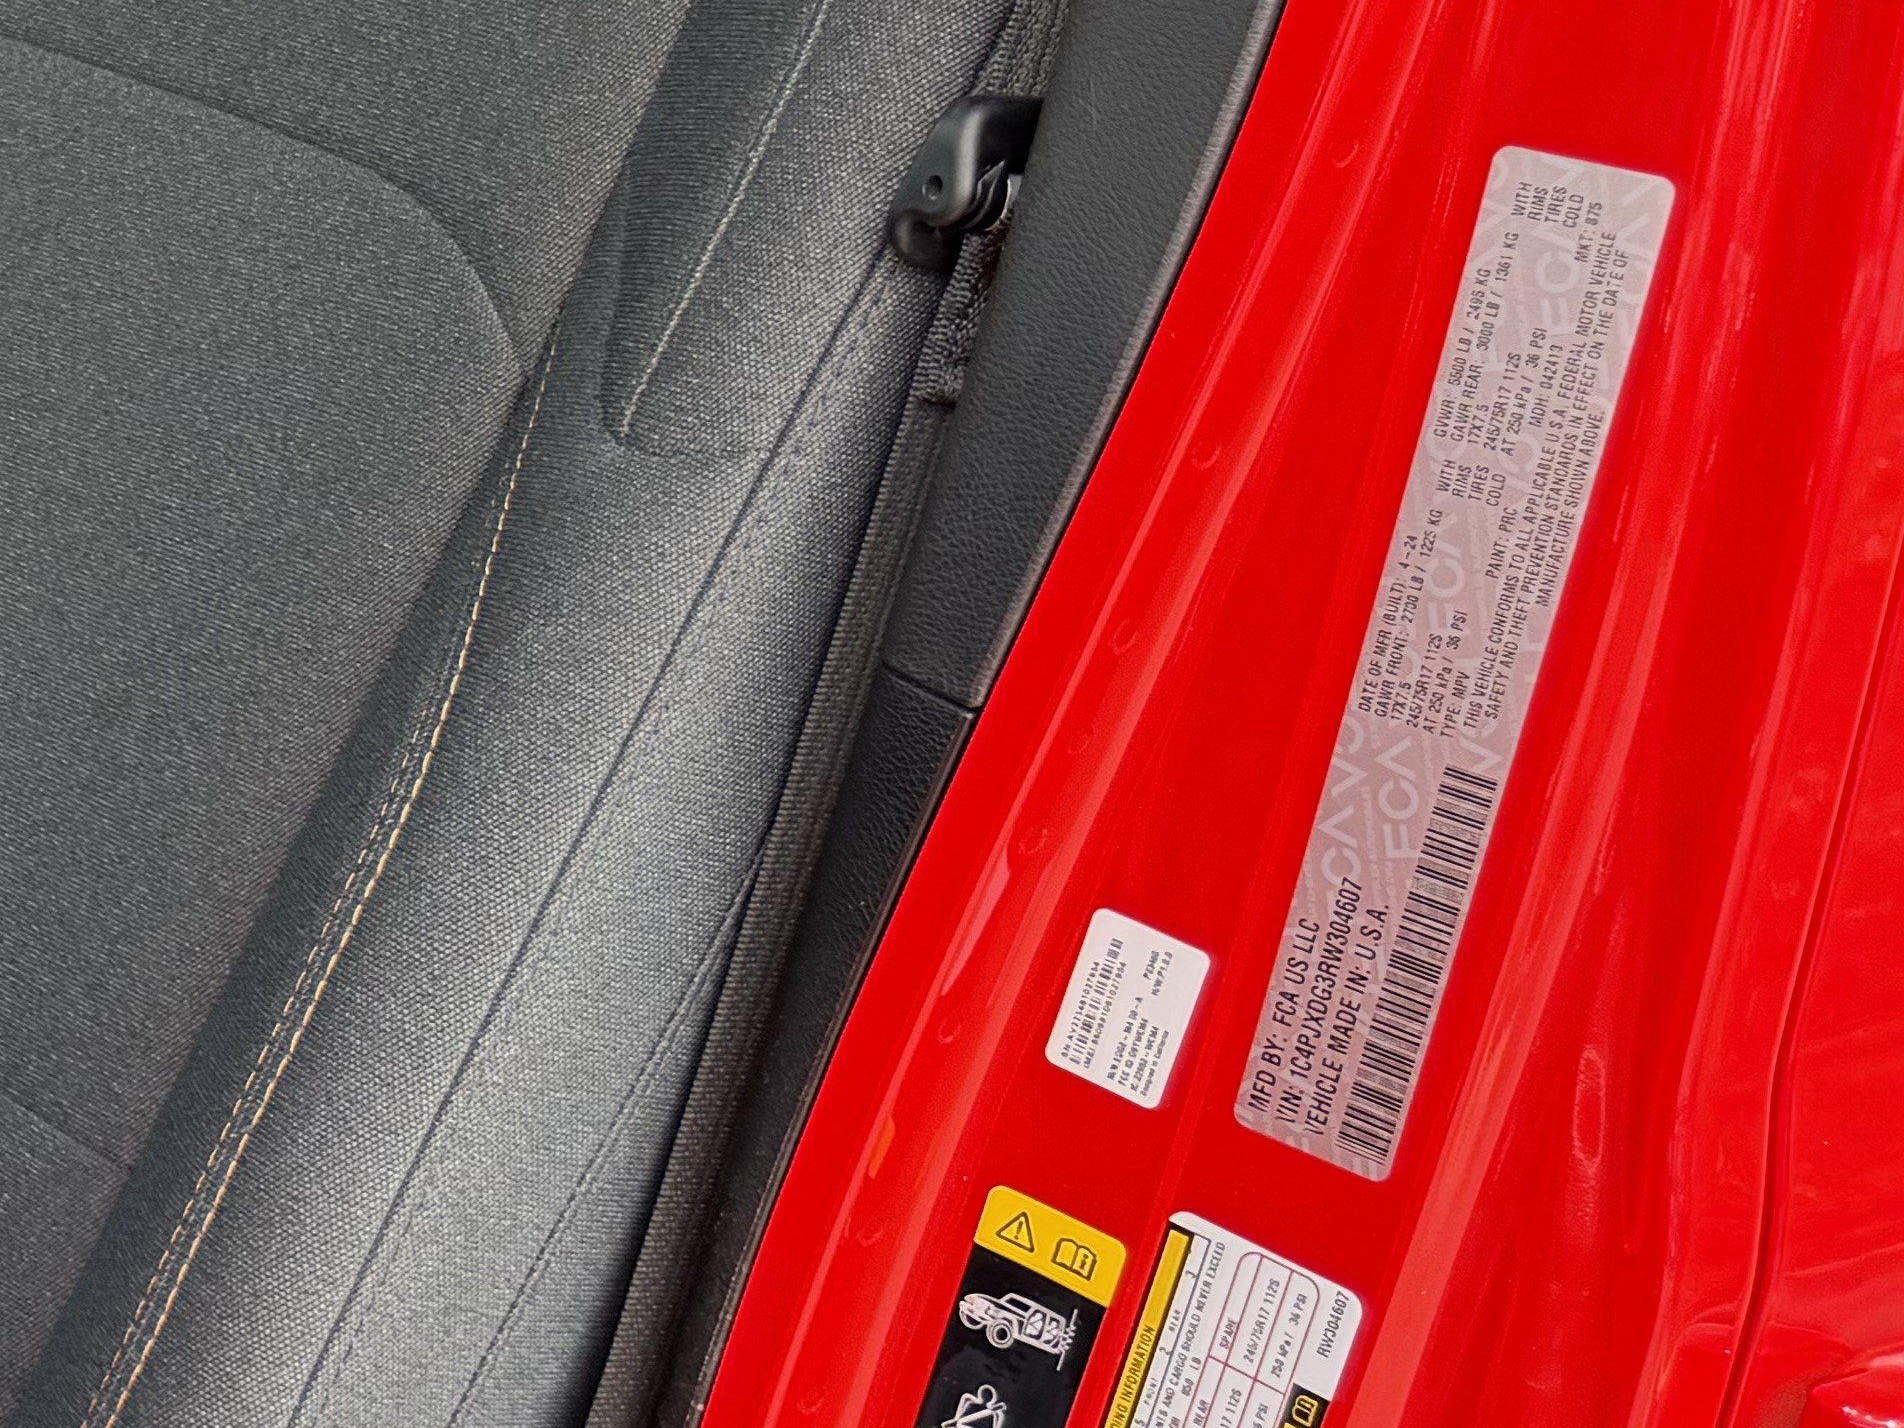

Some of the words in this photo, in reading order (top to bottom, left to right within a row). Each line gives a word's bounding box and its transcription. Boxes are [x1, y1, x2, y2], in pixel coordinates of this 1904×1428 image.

[1510, 181, 1532, 216] WITH
[1527, 186, 1548, 221] RIMS
[1562, 193, 1584, 228] COLD
[1502, 231, 1519, 249] KG
[1494, 254, 1513, 282] 1361
[1588, 231, 1616, 285] VEHICLE
[1612, 249, 1629, 268] OF
[1474, 267, 1491, 286] KG
[1601, 271, 1624, 306] DATE
[1465, 289, 1485, 320] 2495
[1482, 385, 1511, 450] 245/75R17
[1501, 351, 1521, 380] 112S
[1544, 185, 1567, 223] TIRES
[1483, 301, 1500, 317] LB
[1574, 290, 1600, 336] MOTOR
[1475, 320, 1495, 351] 3000
[1528, 326, 1547, 348] PSI
[1592, 309, 1614, 336] THE
[1456, 336, 1472, 353] LB
[1524, 352, 1540, 368] 36
[1586, 340, 1605, 360] ON
[1447, 356, 1467, 386] 5500
[1556, 341, 1586, 399] FEDERAL
[1571, 362, 1598, 411] EFFECT
[1512, 385, 1531, 408] kPa
[1527, 396, 1549, 427] MDH:
[1433, 393, 1455, 437] GVWR:
[1449, 402, 1472, 442] GAWR
[1505, 411, 1524, 434] 250
[1566, 414, 1584, 429] IN
[1499, 437, 1516, 456] AT
[1435, 458, 1456, 492] WITH
[1451, 464, 1472, 497] RIMS
[1521, 446, 1556, 523] APPLICABLE
[1543, 432, 1578, 511] STANDARDS
[1484, 472, 1506, 507] COLD
[1426, 508, 1443, 526] KG
[1535, 510, 1574, 607] MANUFACTURE
[1563, 459, 1590, 508] SHOWN
[1418, 529, 1437, 557] 1225
[1484, 538, 1509, 579] PAINT:
[1497, 506, 1518, 533] PRC
[1513, 528, 1533, 550] ALL
[1520, 513, 1555, 594] PREVENTION
[1507, 553, 1525, 570] TO
[1405, 664, 1433, 728] 245/75R17
[1423, 632, 1443, 661] 112S
[1468, 464, 1490, 501] TIRES
[1408, 575, 1424, 591] LB
[1399, 593, 1419, 623] 2700
[1450, 609, 1468, 631] PSI
[1487, 574, 1519, 644] CONFORMS
[1506, 597, 1530, 637] THEFT
[1372, 628, 1392, 657] MFR
[1385, 630, 1409, 676] FRONT:
[1445, 634, 1461, 650] 36
[1498, 640, 1518, 669] AND
[1367, 658, 1382, 677] OF
[1434, 666, 1452, 689] kPa
[1471, 645, 1499, 697] VEHICLE
[1357, 678, 1378, 712] DATE
[1373, 679, 1395, 717] GAWR
[1427, 690, 1445, 714] 250
[1439, 702, 1461, 738] TYPE:
[1451, 670, 1470, 699] MPV
[1483, 670, 1509, 719] SAFETY
[1421, 715, 1437, 734] AT
[1462, 700, 1483, 729] THIS
[1375, 736, 1418, 862] FCA
[1291, 917, 1319, 954] LLC
[1353, 904, 1389, 960] U.S.A.
[1282, 956, 1309, 985] US
[1289, 877, 1360, 1078] 1C4PJXDG3RW304607
[1343, 965, 1371, 994] IN:
[1271, 990, 1300, 1027] FCA
[1326, 996, 1361, 1055] MADE
[1260, 1033, 1287, 1067] BY:
[1247, 1069, 1276, 1112] MFD
[1275, 1085, 1304, 1123] VIN:
[1303, 1057, 1343, 1135] VEHICLE
[1161, 1386, 1175, 1408] AND
[1168, 1352, 1187, 1386] CARGO
[1180, 1312, 1201, 1352] SHOULD
[1194, 1279, 1212, 1311] NEVER
[1204, 1241, 1225, 1278] EXCEED
[1218, 1317, 1236, 1349] SPARE
[1242, 1306, 1270, 1363] 245/75R17
[1262, 1277, 1280, 1304] 112S
[1316, 1290, 1349, 1358] RW304607
[1119, 1324, 1154, 1402] INFORMATION
[1188, 1355, 1201, 1370] LB
[1192, 1398, 1209, 1426] REAR
[1224, 1387, 1242, 1414] 112S
